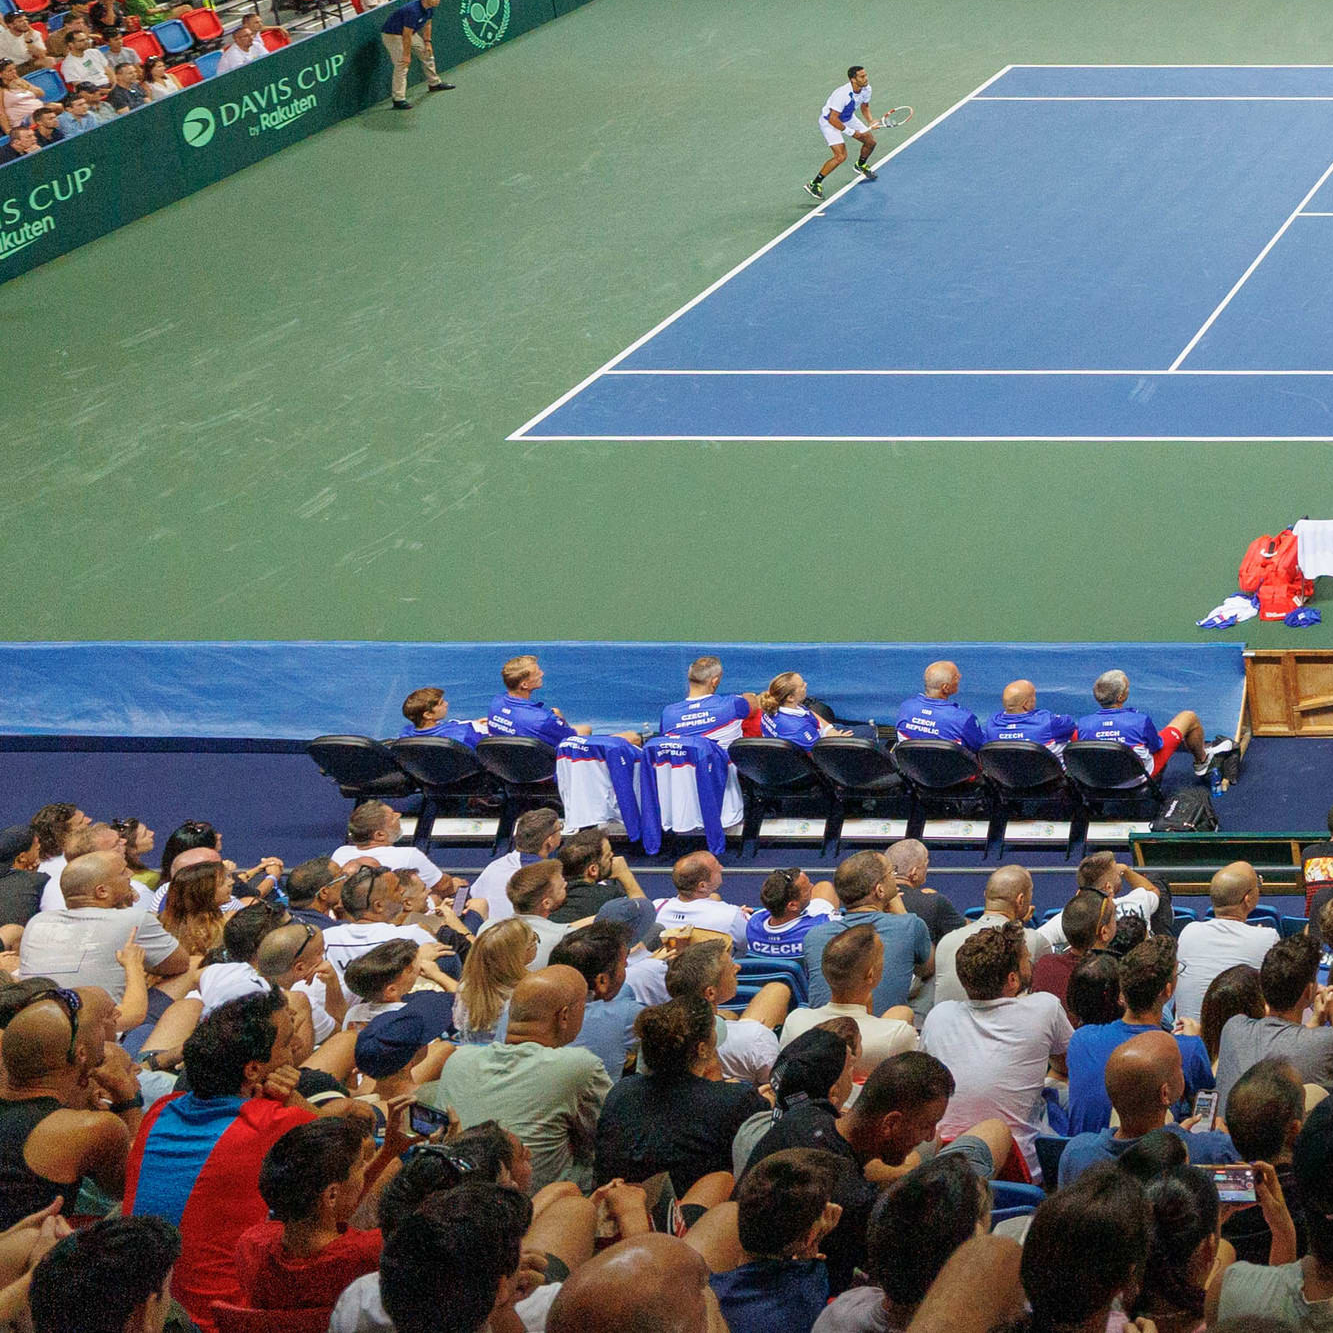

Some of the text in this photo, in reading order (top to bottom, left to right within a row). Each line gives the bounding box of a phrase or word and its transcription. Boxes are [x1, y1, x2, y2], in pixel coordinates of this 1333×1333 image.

[219, 53, 345, 127] DAVIS CUP
[249, 94, 318, 137] by Rakuten
[28, 166, 93, 211] CUP
[0, 215, 56, 253] kuten
[492, 714, 513, 728] CZECH
[676, 716, 716, 729] REPUBLIC
[681, 711, 709, 722] CZECH
[912, 716, 936, 728] CZECH
[488, 720, 516, 736] REPUBLIC
[906, 723, 939, 735] REPUBLIC
[1096, 730, 1120, 738] CZECH
[999, 732, 1024, 740] CZECH
[752, 940, 803, 954] CZECH
